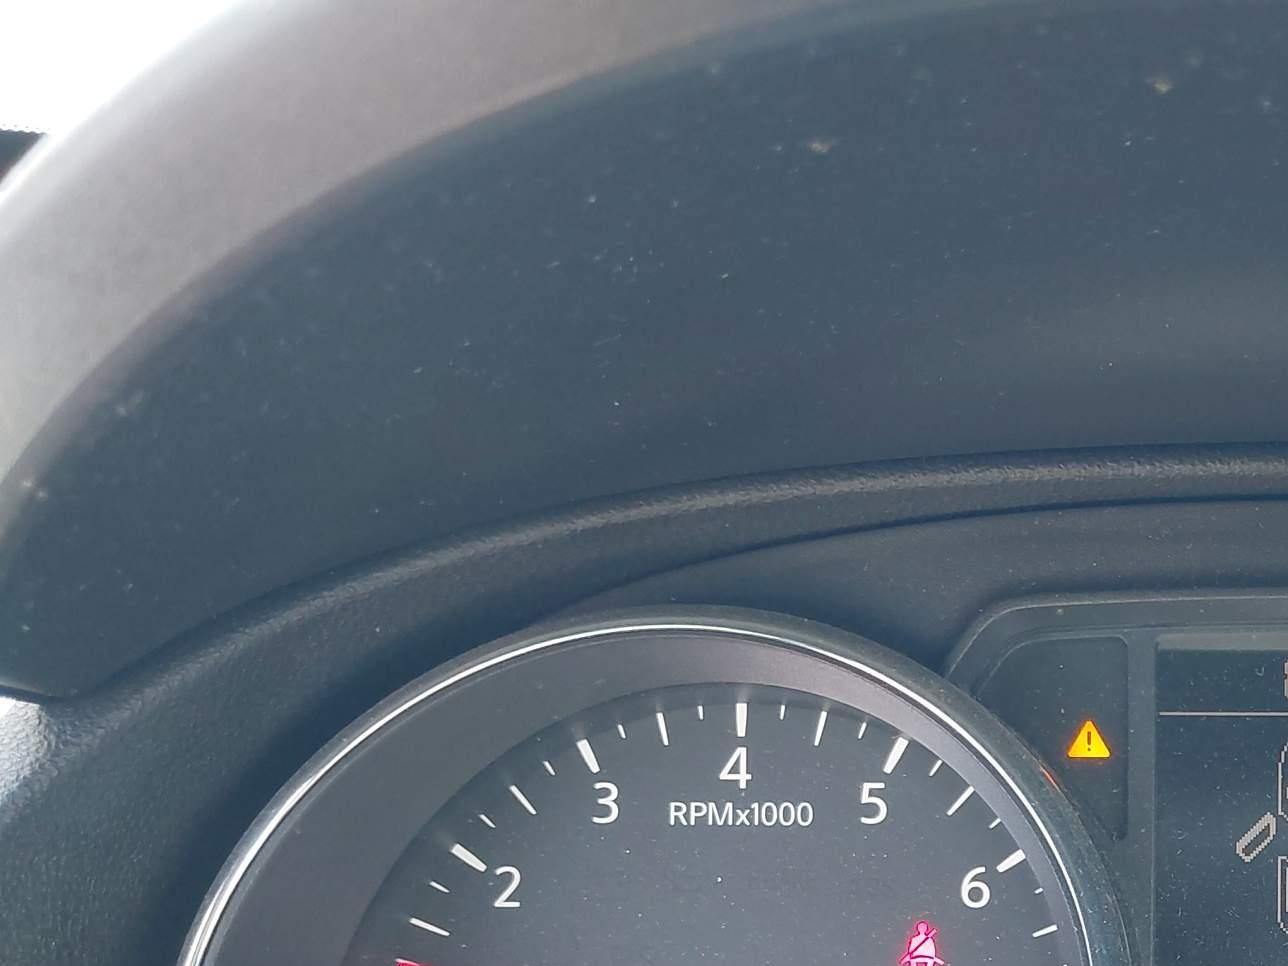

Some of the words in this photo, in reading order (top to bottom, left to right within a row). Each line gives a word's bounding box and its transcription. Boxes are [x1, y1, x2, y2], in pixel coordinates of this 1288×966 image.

[719, 746, 752, 789] 4
[592, 782, 619, 824] 3
[669, 801, 814, 828] RPMx1000
[860, 782, 887, 824] 5
[493, 866, 521, 908] 2
[961, 865, 991, 908] 6
